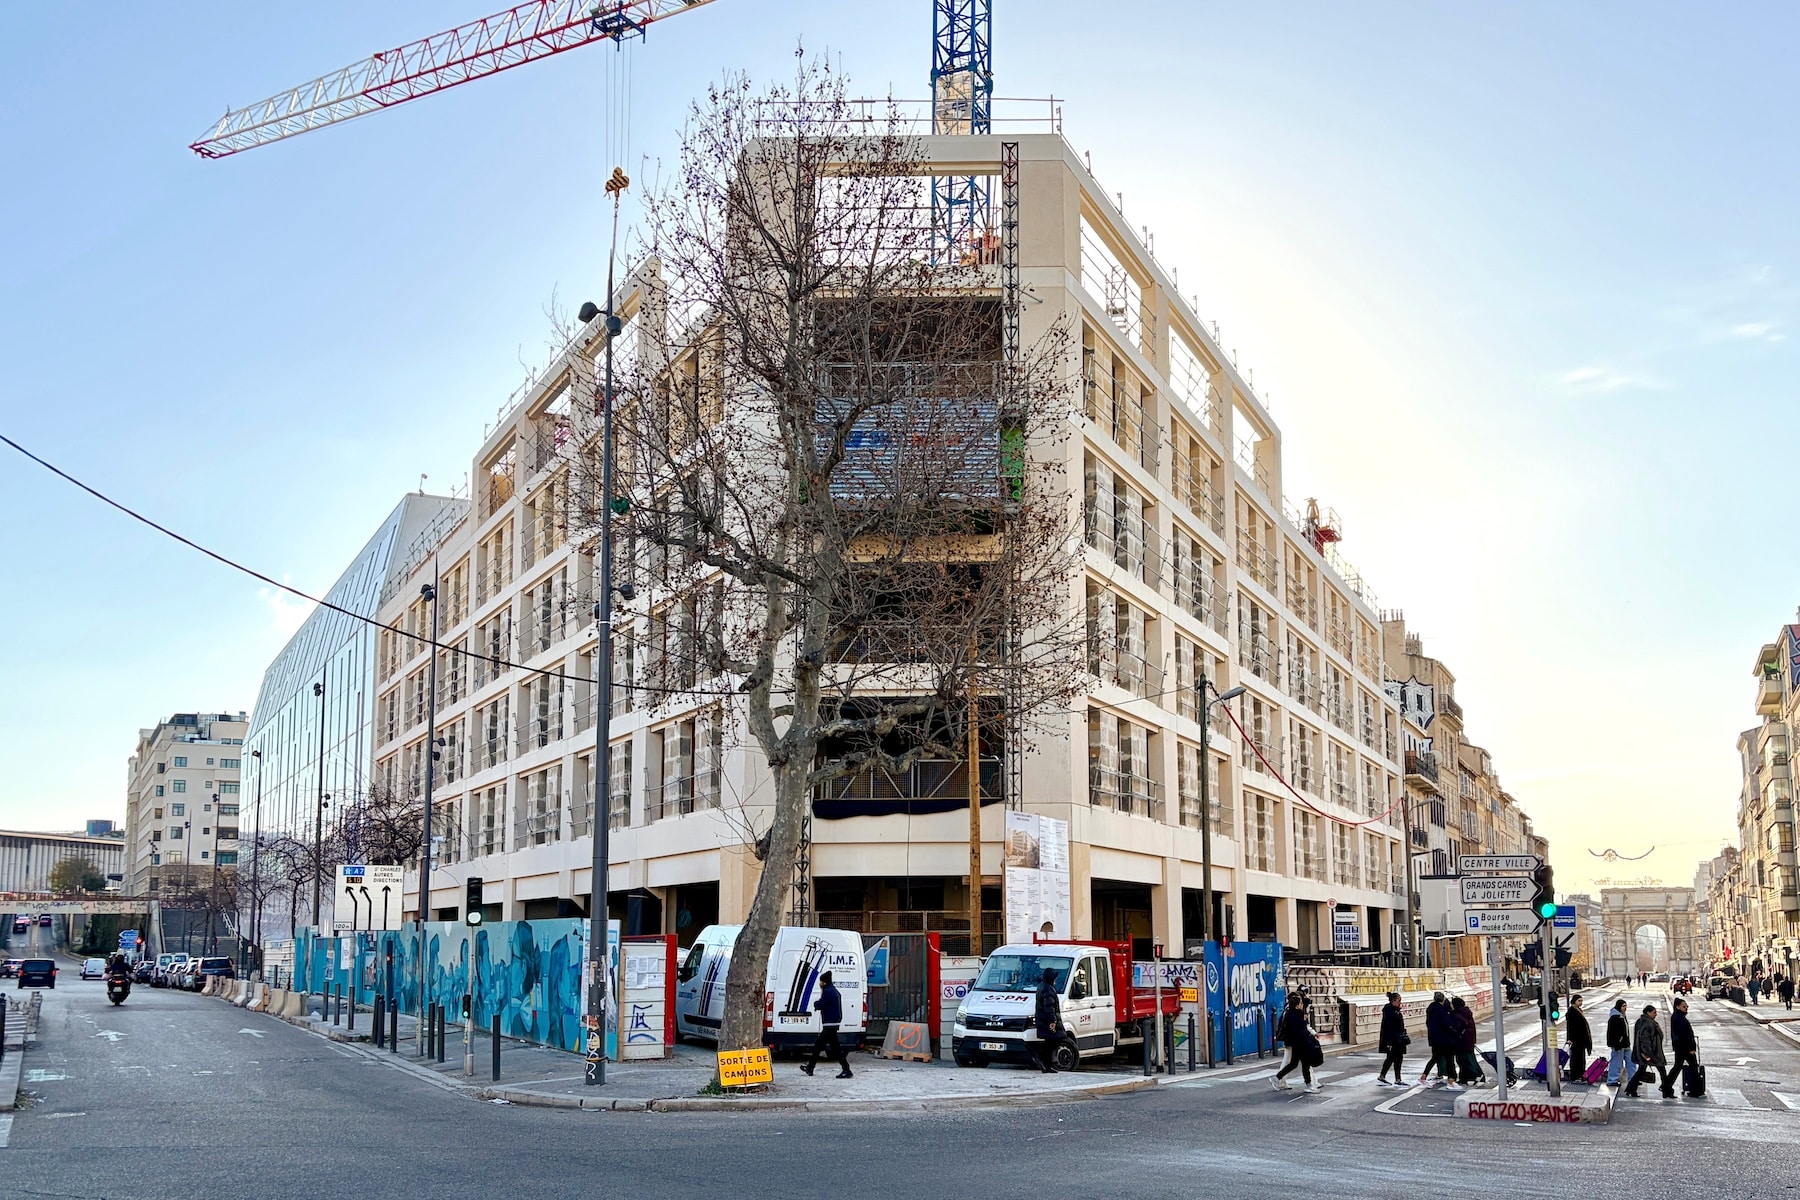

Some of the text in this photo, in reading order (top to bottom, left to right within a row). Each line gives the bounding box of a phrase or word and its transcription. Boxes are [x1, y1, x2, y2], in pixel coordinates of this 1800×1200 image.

[1464, 859, 1530, 868] CENTRE VILLE
[1466, 880, 1527, 890] GRANDS CARMES
[1466, 890, 1521, 900] LA JOLIETTE
[1481, 913, 1510, 921] Bourse
[1481, 922, 1530, 931] musée d'histoire
[1231, 960, 1267, 1007] OMNES
[724, 1068, 767, 1078] CAMIONS
